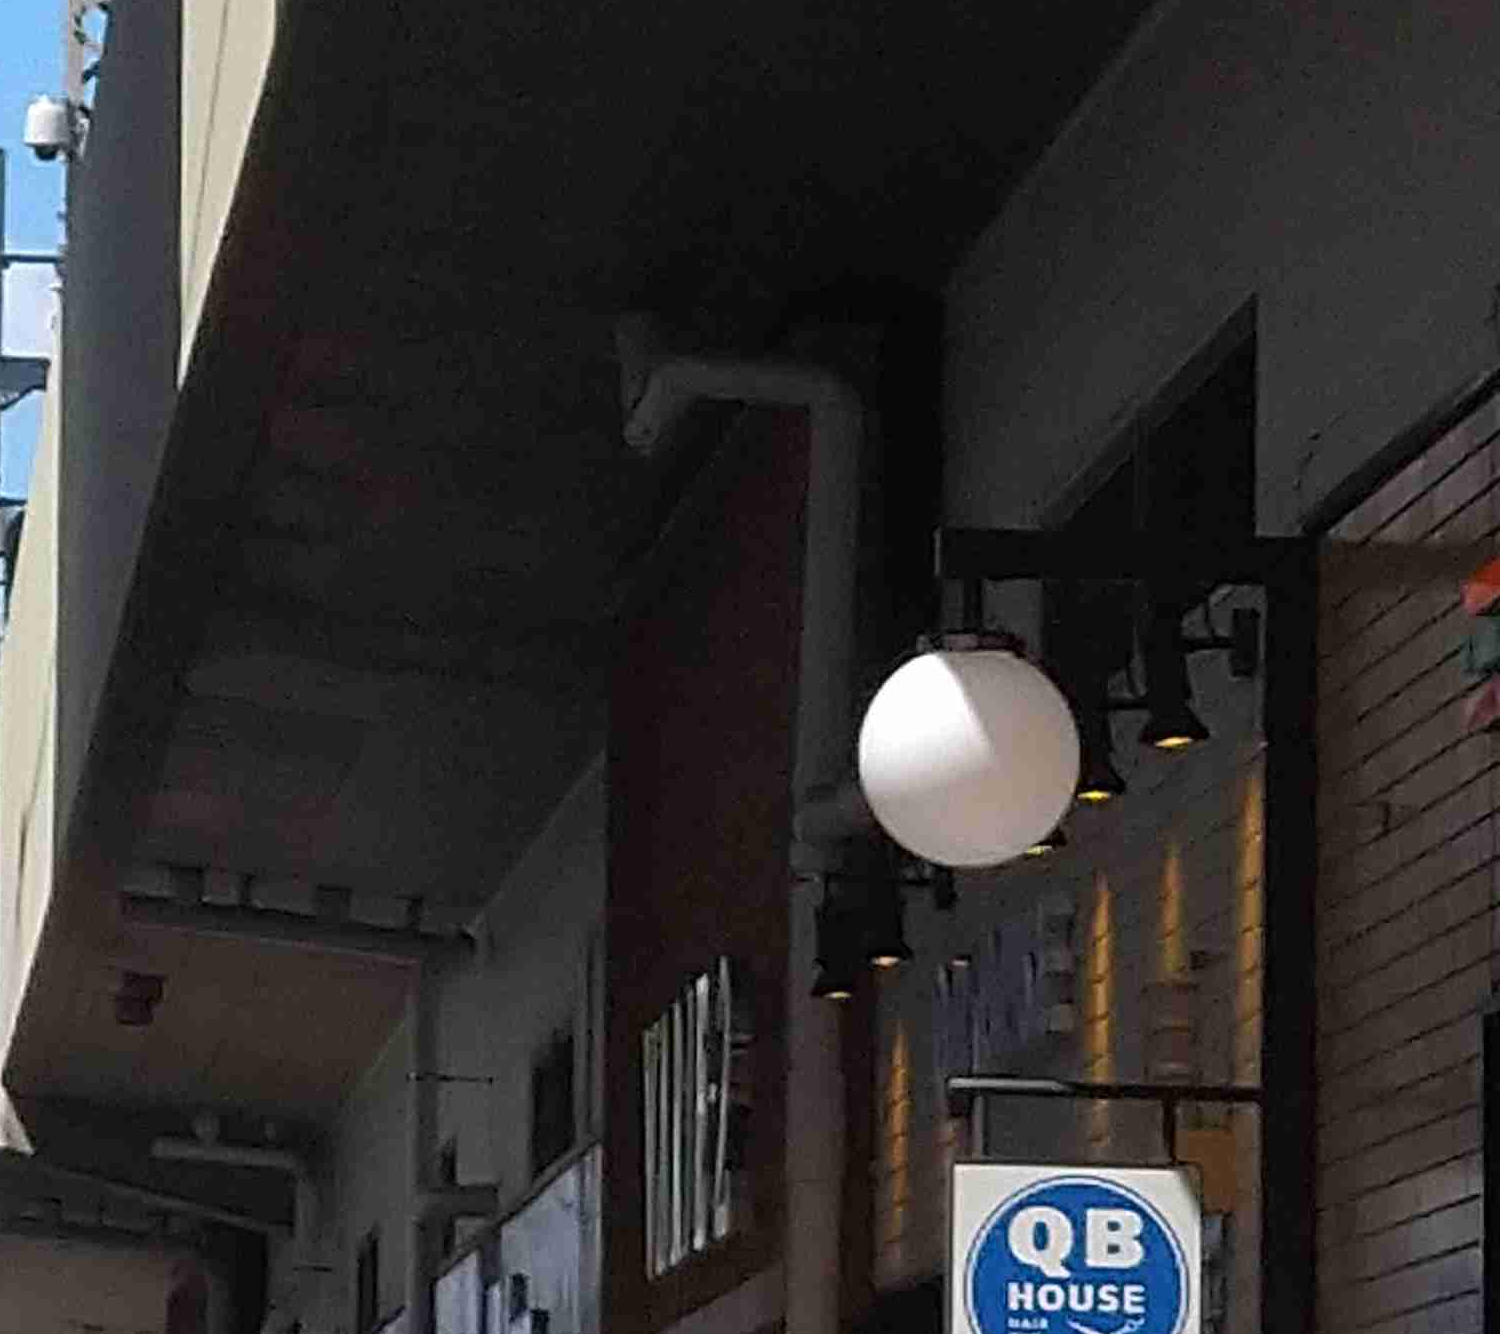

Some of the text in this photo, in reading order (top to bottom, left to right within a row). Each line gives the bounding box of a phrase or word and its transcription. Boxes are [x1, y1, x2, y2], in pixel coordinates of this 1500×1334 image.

[1006, 1205, 1146, 1279] QB
[1007, 1282, 1146, 1315] HOUSE
[1007, 1317, 1049, 1331] HAIR
